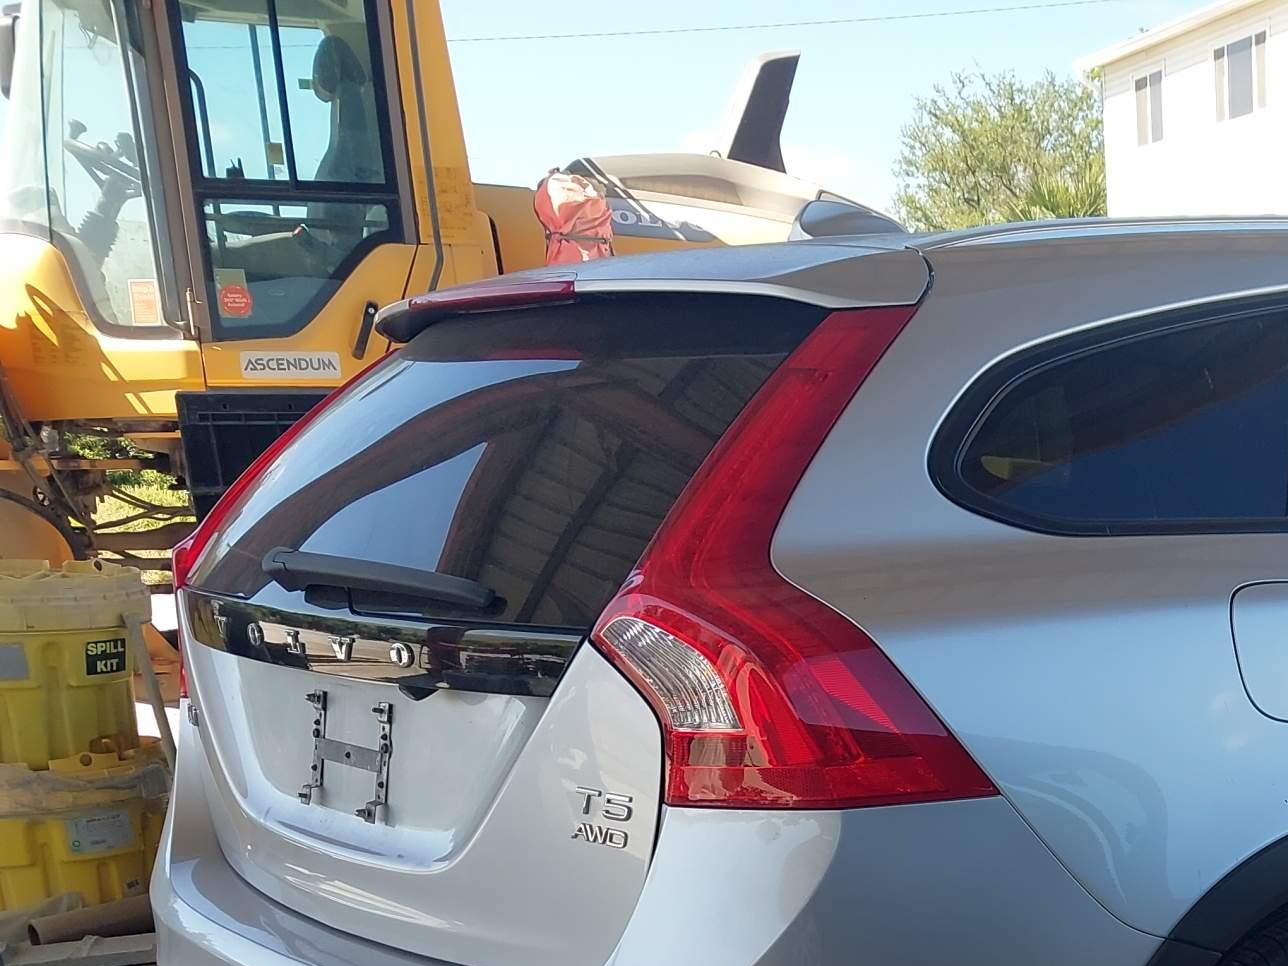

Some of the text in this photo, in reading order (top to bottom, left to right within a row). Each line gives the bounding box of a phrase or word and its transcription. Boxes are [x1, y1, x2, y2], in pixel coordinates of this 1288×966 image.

[244, 358, 337, 371] ASCENDUM
[87, 640, 124, 655] SPILL
[213, 613, 415, 668] VOLVO
[96, 658, 119, 672] KIT
[575, 786, 633, 822] T5
[571, 822, 628, 849] AWD
